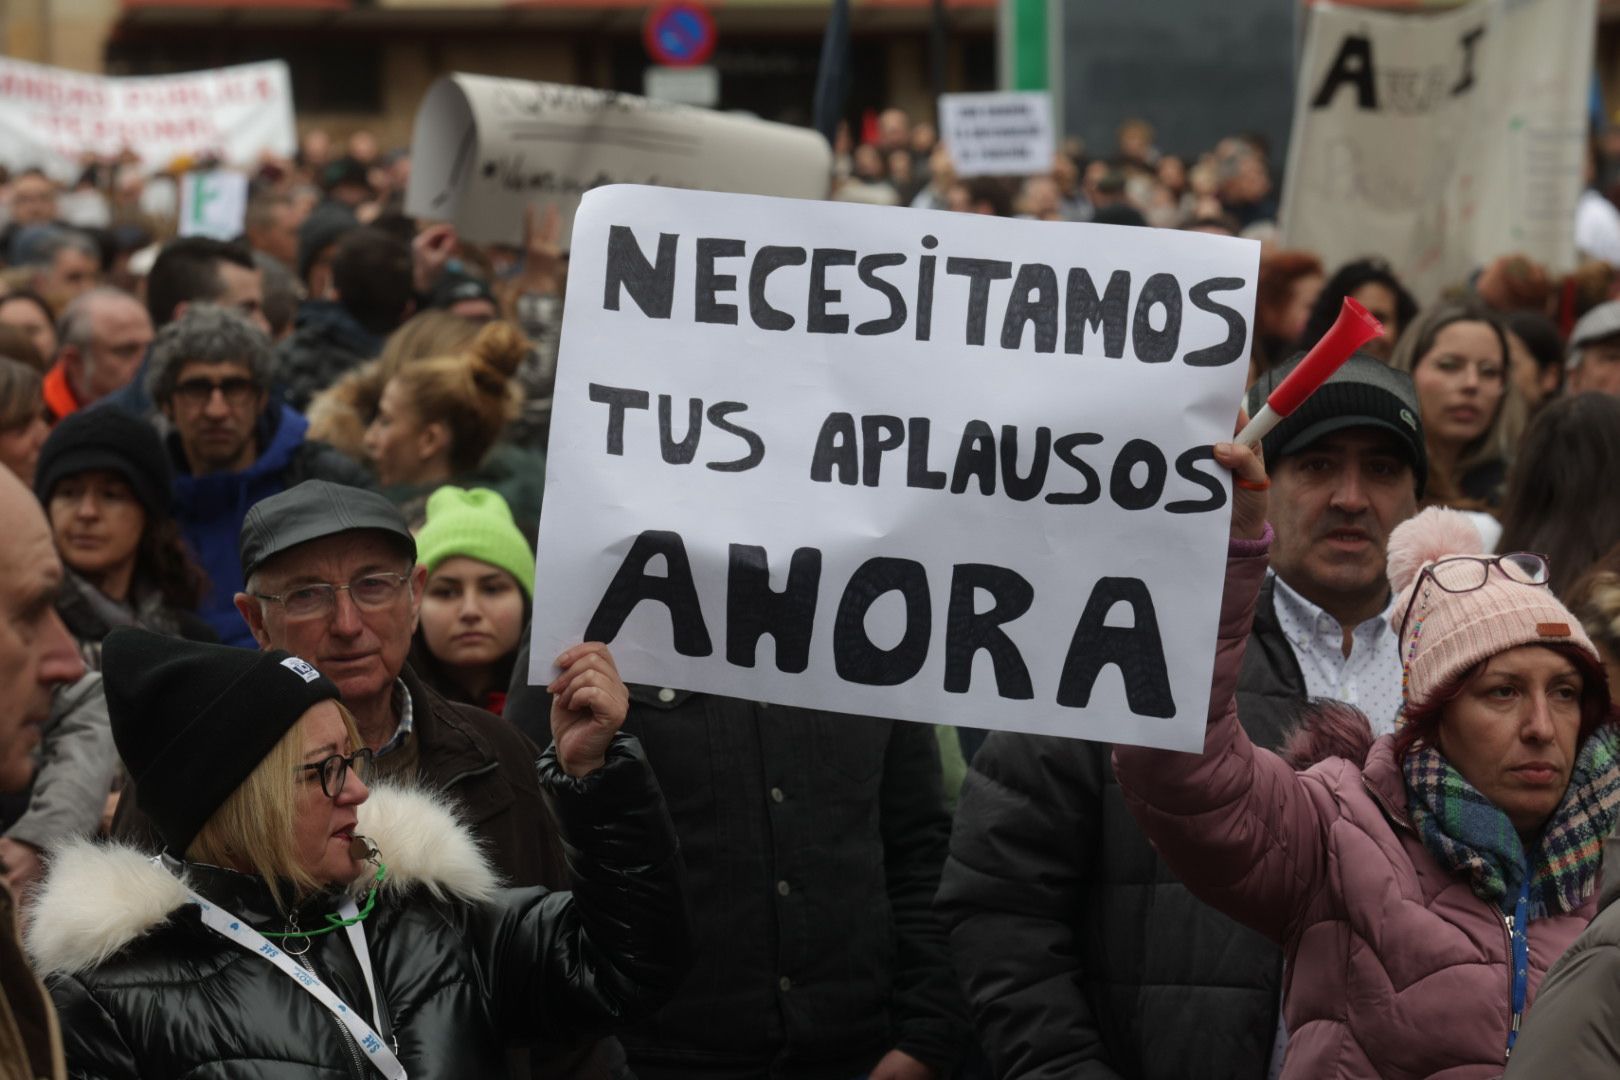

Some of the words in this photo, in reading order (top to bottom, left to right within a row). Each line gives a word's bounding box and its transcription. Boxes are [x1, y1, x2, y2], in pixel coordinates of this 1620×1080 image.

[588, 382, 766, 473] TUS
[810, 411, 1235, 514] APLAUSOS
[582, 529, 1177, 720] AHORA
